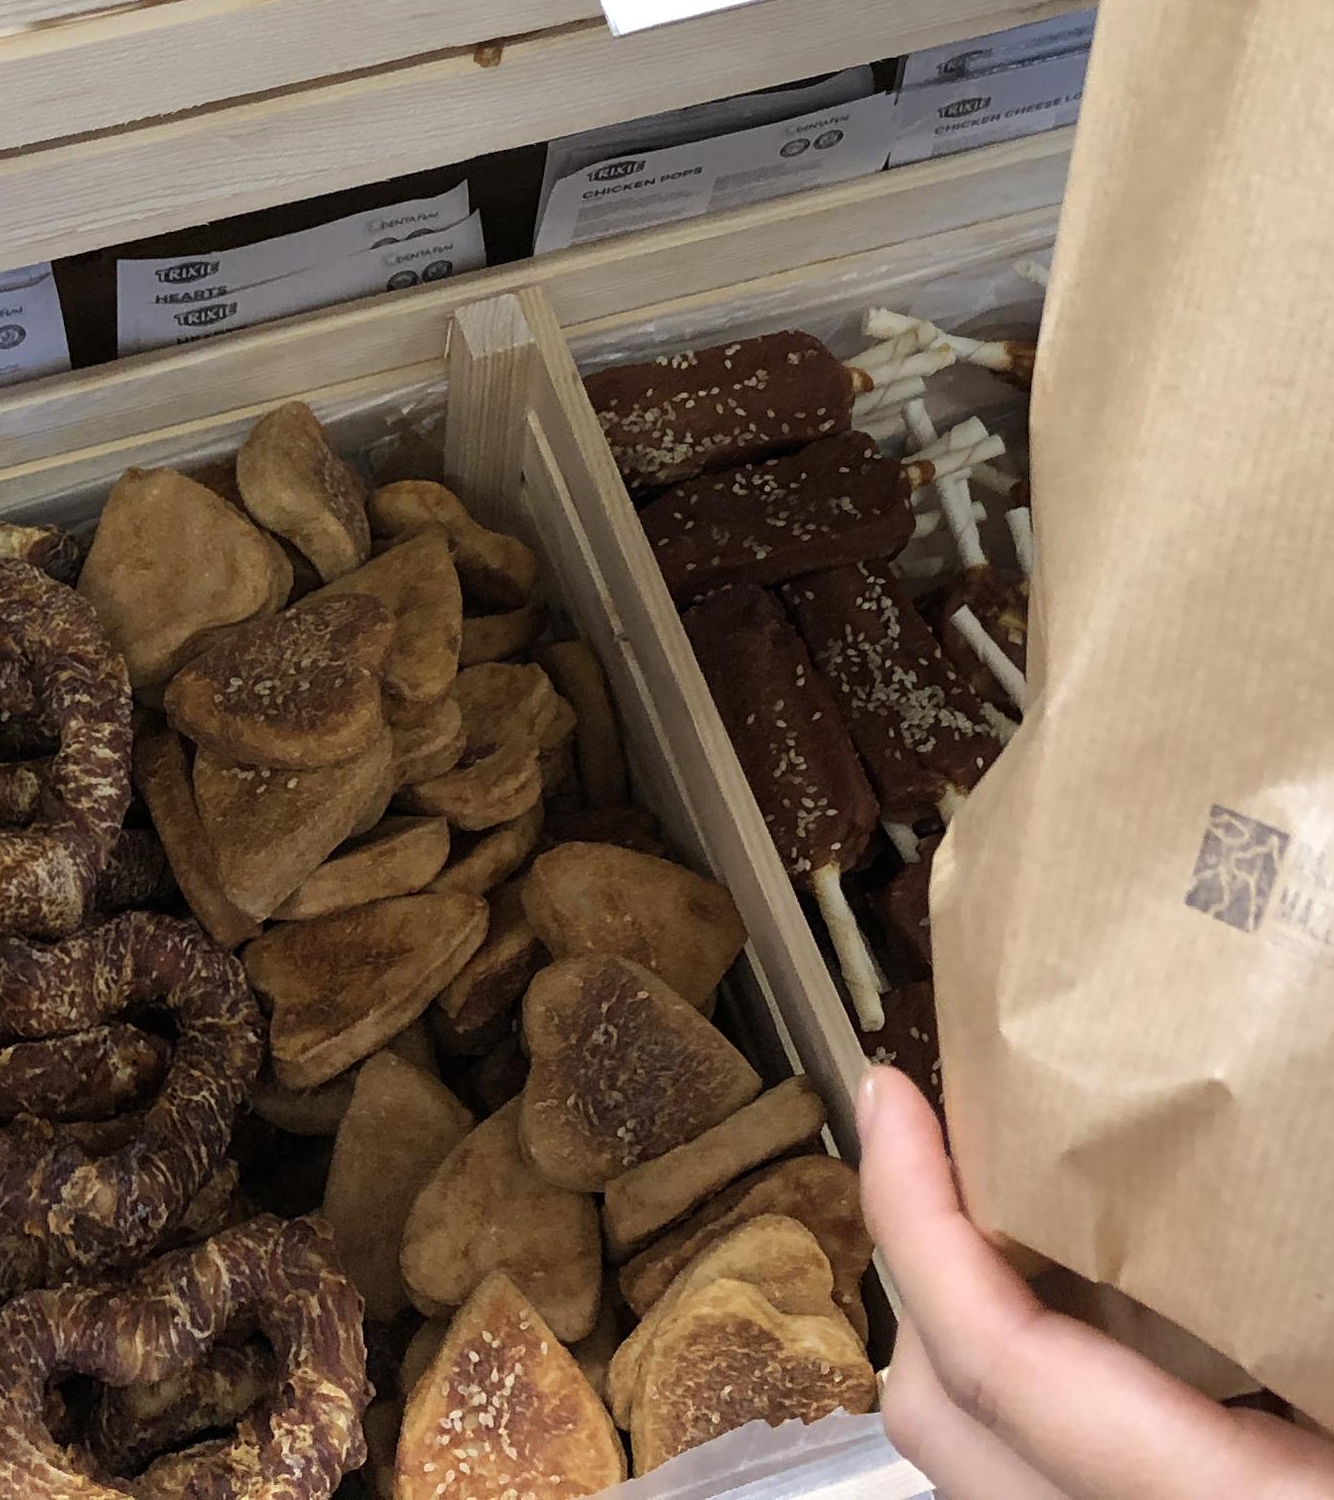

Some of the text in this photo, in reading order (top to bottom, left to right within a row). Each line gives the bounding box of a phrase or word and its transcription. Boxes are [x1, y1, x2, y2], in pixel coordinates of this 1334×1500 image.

[934, 112, 1001, 135] CHICKEN
[1003, 97, 1061, 120] CHEESE
[582, 176, 656, 200] CHICKEN
[659, 165, 704, 182] POPS
[585, 159, 647, 183] TRIXIE
[154, 260, 220, 285] TRIXIE
[154, 284, 228, 305] HEARTS
[173, 301, 238, 328] TRIXIE
